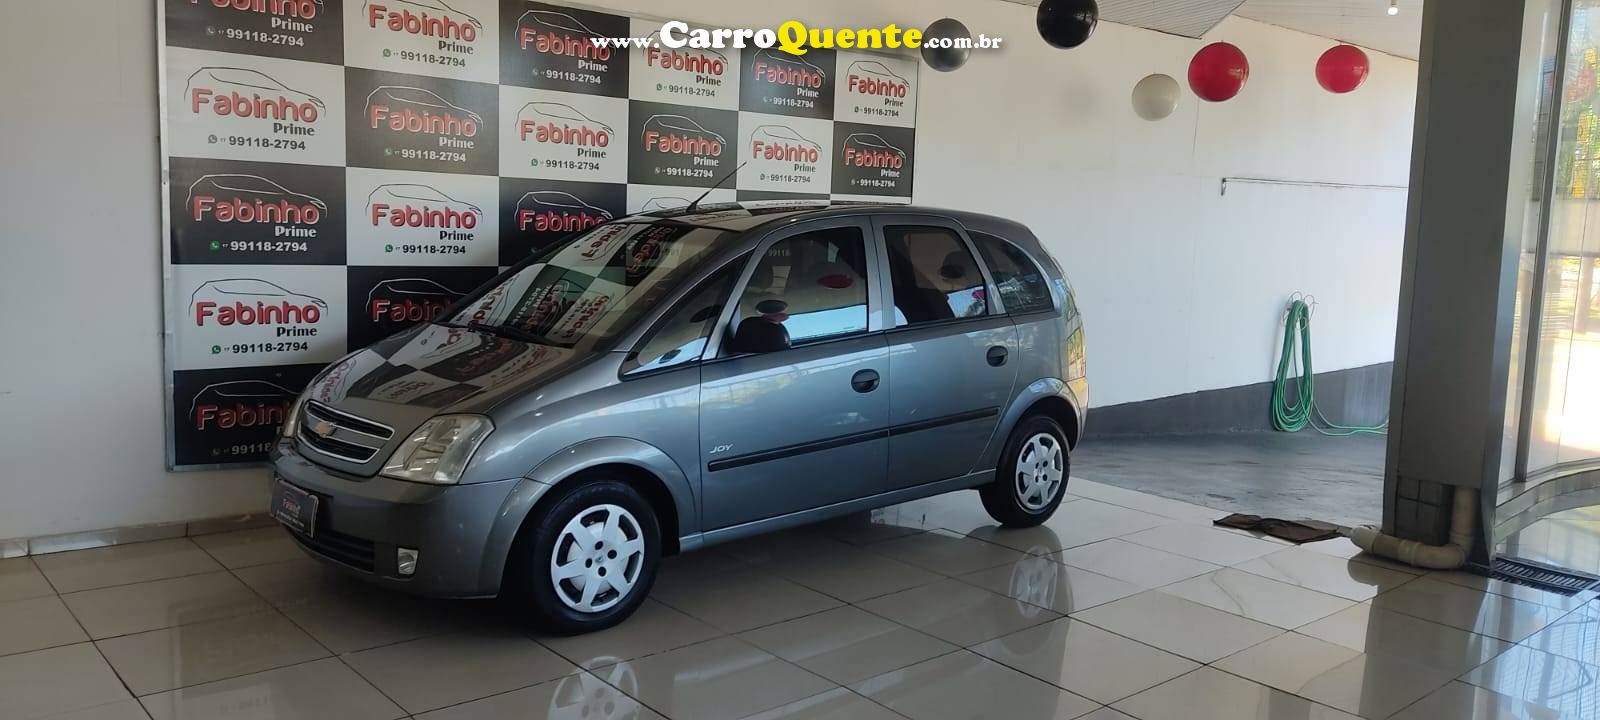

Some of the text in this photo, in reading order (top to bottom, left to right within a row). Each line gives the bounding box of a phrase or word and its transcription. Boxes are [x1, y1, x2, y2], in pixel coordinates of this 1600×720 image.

[271, 17, 313, 33] Prime
[368, 4, 476, 42] Fabinho
[226, 28, 305, 47] 99118-2794
[520, 27, 611, 60] Fabinho
[438, 40, 474, 55] Prime
[400, 50, 466, 68] 99118-2794
[578, 59, 608, 72] Prime
[648, 47, 724, 75] Fabinho
[546, 69, 601, 84] 99118-2794
[696, 75, 721, 86] Prime
[755, 61, 822, 89] Fabinho
[669, 84, 715, 97] 99118-2794
[797, 88, 819, 98] Prime
[848, 75, 906, 98] Fabinho
[191, 88, 319, 123] Fabinho
[773, 97, 814, 109] 99118-2794
[369, 104, 477, 138] Fabinho
[273, 122, 315, 136] Prime
[520, 120, 609, 147] Fabinho
[228, 136, 306, 151] 99118-2794
[439, 136, 474, 149] Prime
[645, 131, 722, 156] Fabinho
[402, 149, 467, 162] 99118-2794
[577, 148, 607, 158] Prime
[752, 141, 818, 163] Fabinho
[844, 147, 903, 169] Fabinho
[545, 160, 600, 170] 99118-2794
[694, 157, 719, 167] Prime
[667, 167, 713, 178] 99118-2794
[193, 196, 320, 225] Fabinho
[371, 203, 476, 229] Fabinho
[275, 224, 317, 238] Prime
[439, 230, 474, 241] Prime
[230, 241, 307, 252] 99118-2794
[402, 244, 466, 255] 99118-2794
[195, 301, 321, 327] Fabinho
[276, 326, 317, 337] Prime
[232, 342, 308, 354] 99118-2794
[232, 442, 272, 455] 99118
[710, 443, 733, 453] JOY
